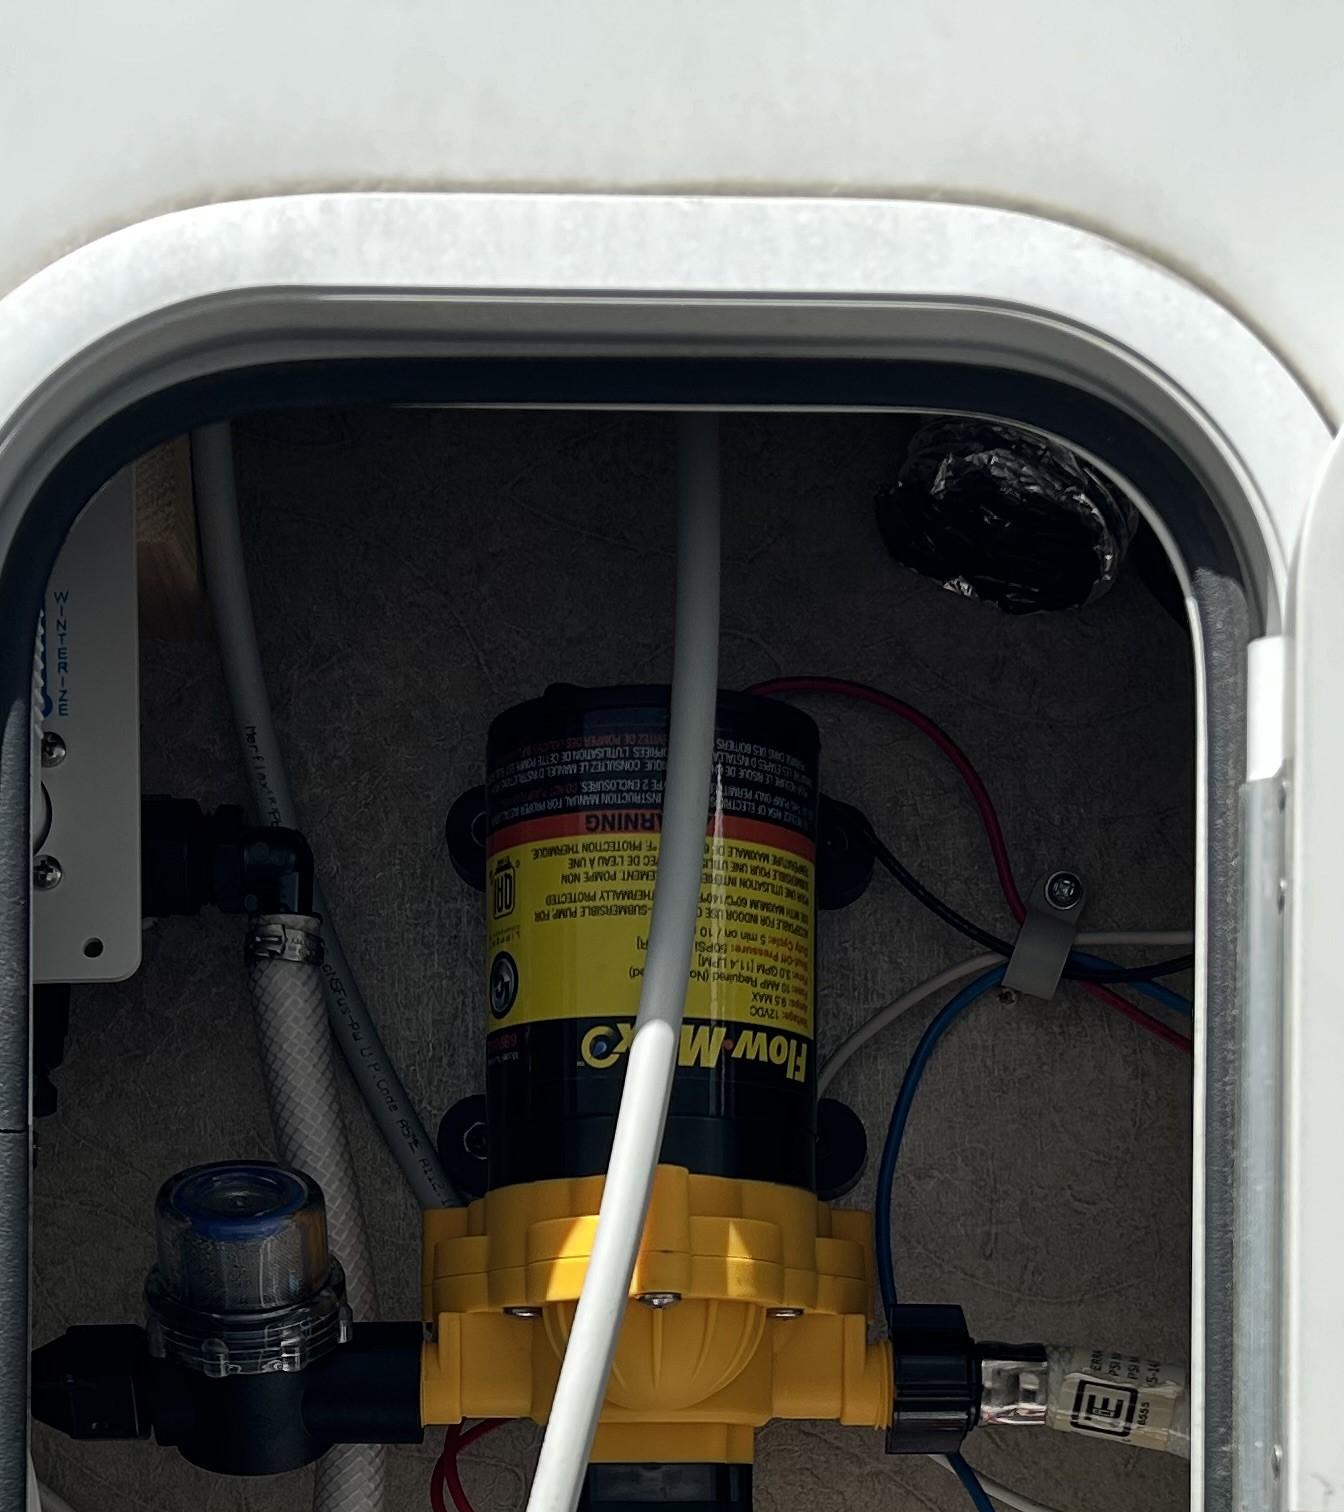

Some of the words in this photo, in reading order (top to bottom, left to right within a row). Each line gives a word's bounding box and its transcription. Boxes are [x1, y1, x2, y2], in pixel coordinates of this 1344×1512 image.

[54, 591, 69, 716] WINTERIZE
[546, 797, 562, 811] FOR
[601, 791, 662, 805] INSTRUCTION
[585, 813, 662, 831] RNING
[582, 841, 642, 854] PROTECTION
[628, 856, 640, 867] DE
[728, 847, 769, 864] MAXIMALE
[568, 857, 586, 869] UNE
[731, 863, 748, 875] UNE
[583, 872, 616, 882] POMPE
[750, 866, 770, 879] POUR
[561, 874, 580, 885] NON
[739, 878, 783, 896] UTILISATION
[545, 892, 596, 906] PROTECTED
[599, 890, 655, 902] THERMALLY
[534, 911, 550, 922] FOR
[580, 905, 651, 917] -SUBMERSIBLE
[726, 910, 758, 924] INDOOR
[760, 914, 775, 929] FOR
[700, 926, 713, 938] 10
[724, 928, 737, 939] on
[740, 931, 758, 943] min
[759, 934, 767, 944] 5
[730, 944, 779, 962] Pressure:
[689, 970, 709, 984] (No
[712, 971, 758, 988] Required
[759, 980, 780, 991] AMP
[751, 992, 773, 1004] MAX
[749, 1006, 779, 1021] 12VDC
